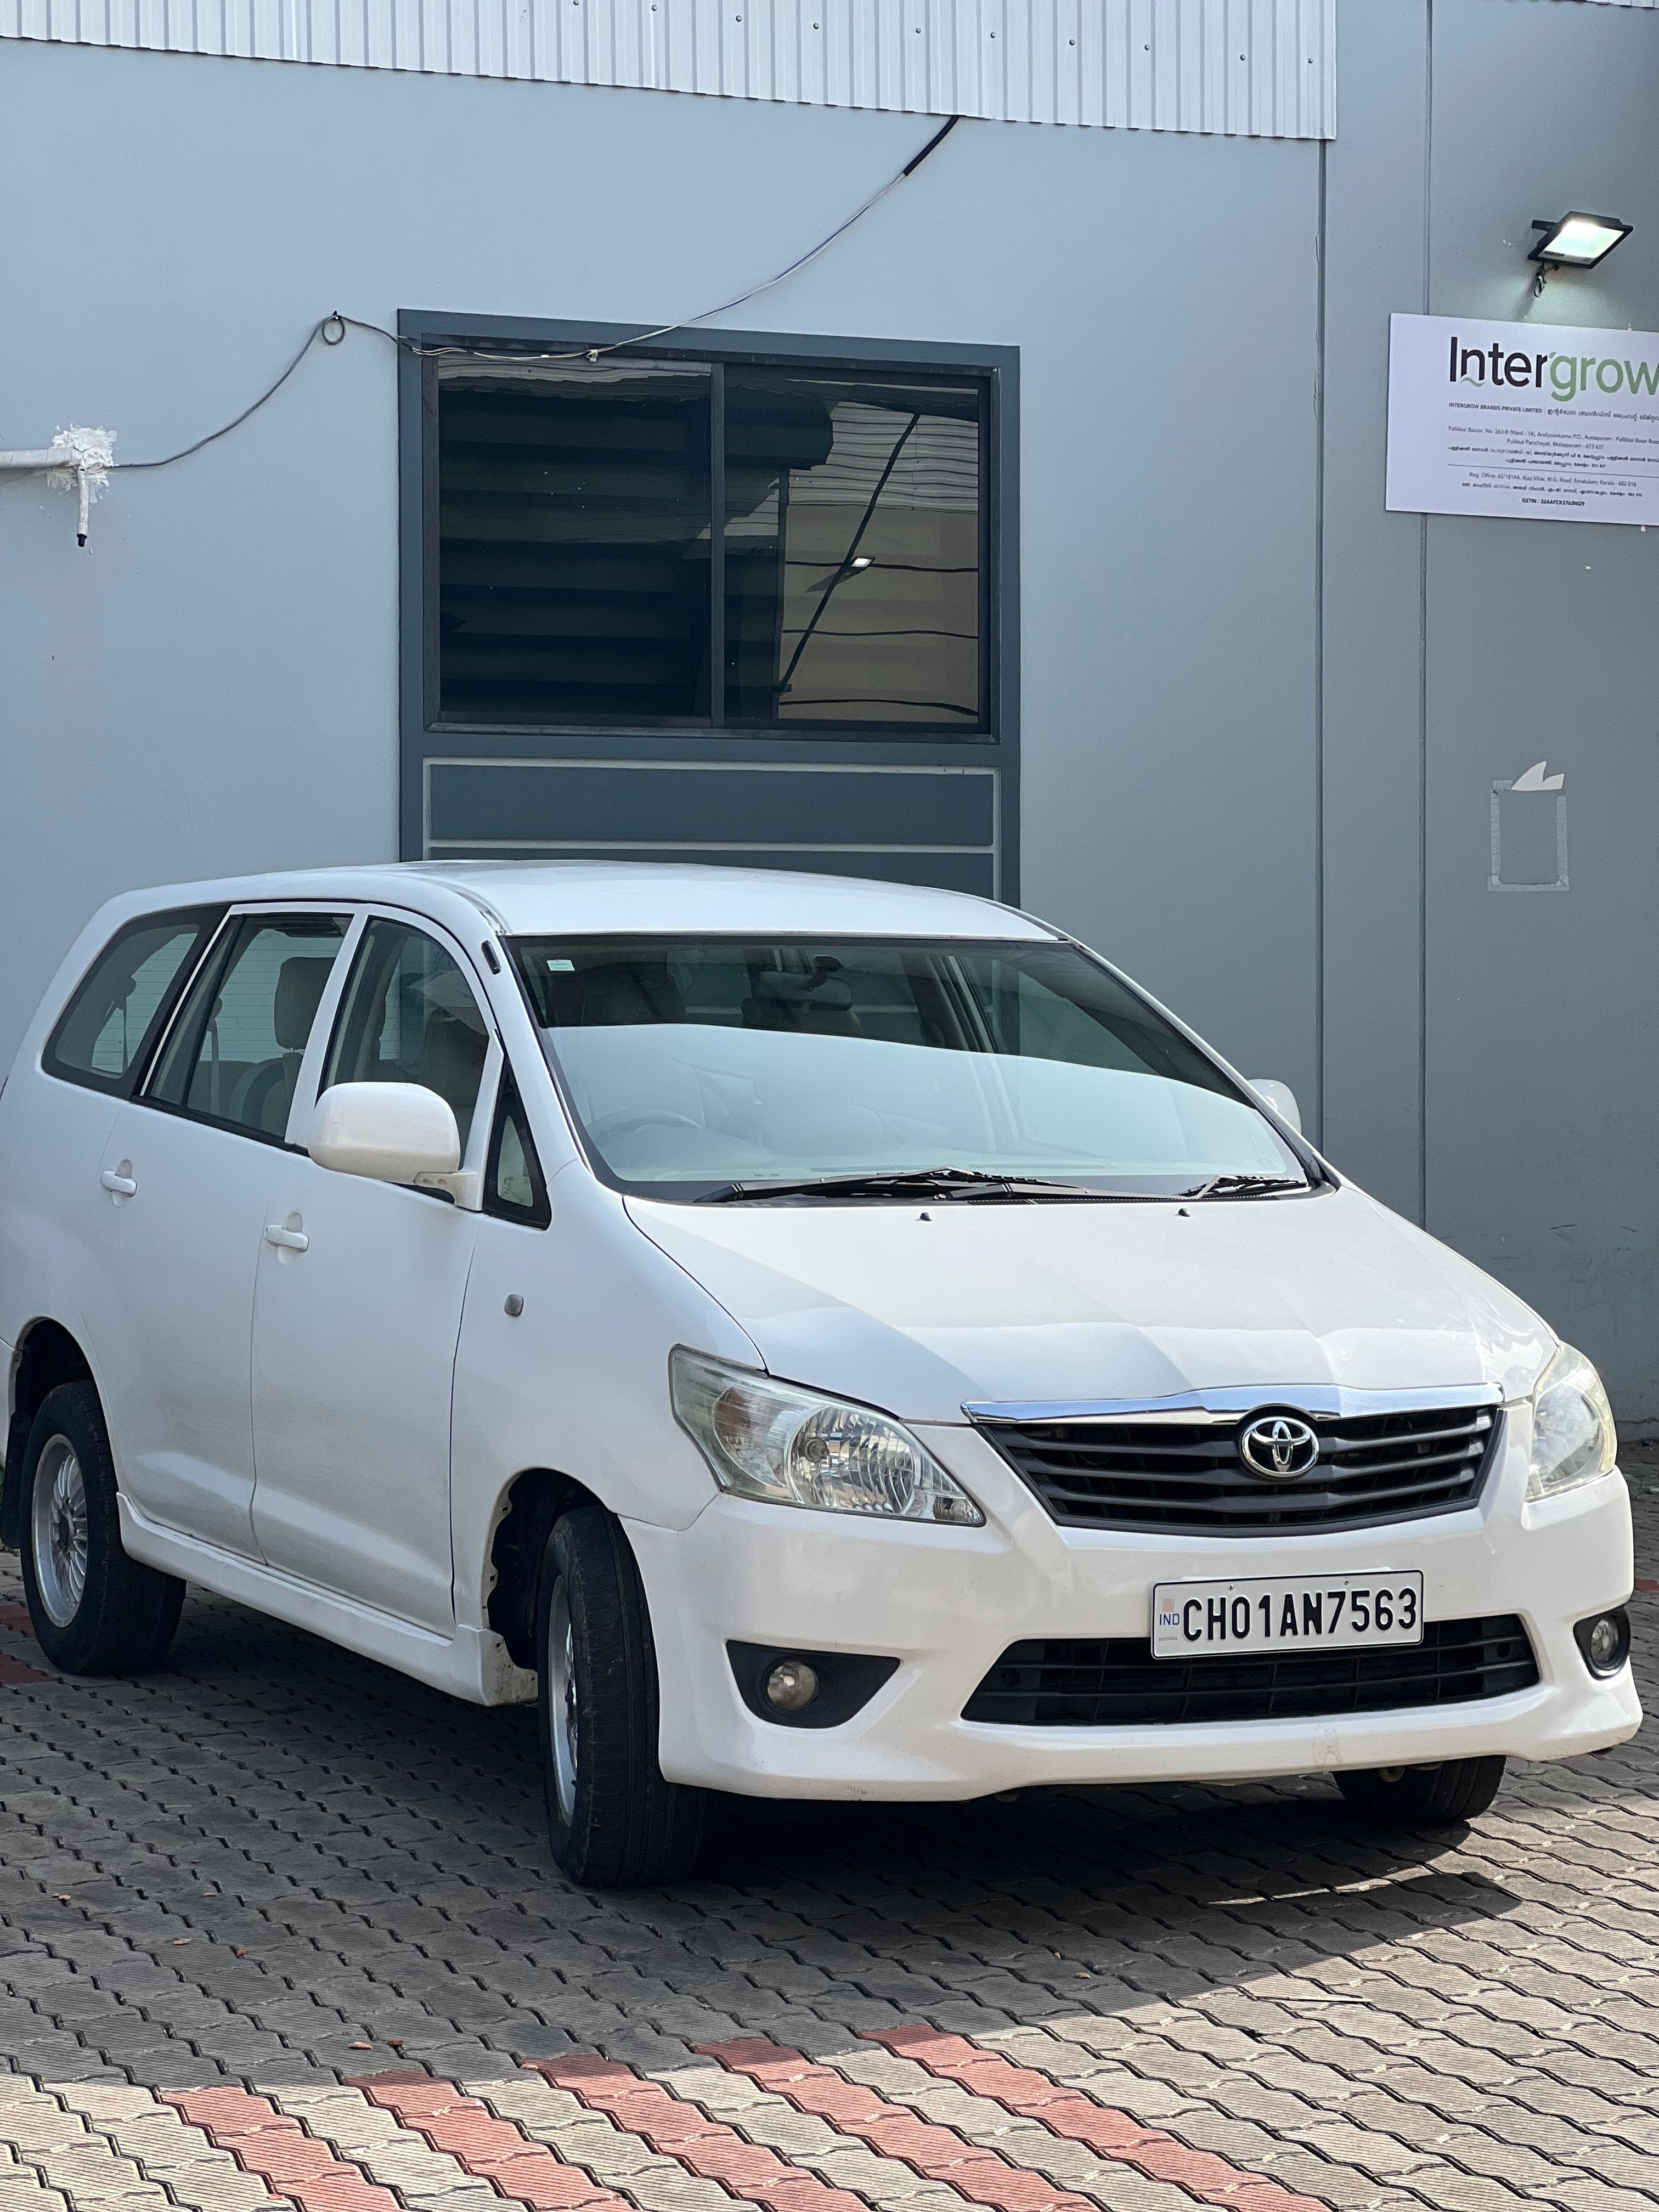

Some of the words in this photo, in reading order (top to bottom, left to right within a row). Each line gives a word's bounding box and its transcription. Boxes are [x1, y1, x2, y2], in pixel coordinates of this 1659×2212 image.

[1449, 336, 1659, 402] Intergrow
[1159, 1613, 1180, 1626] IND
[1183, 1588, 1417, 1641] CH01AN7563
